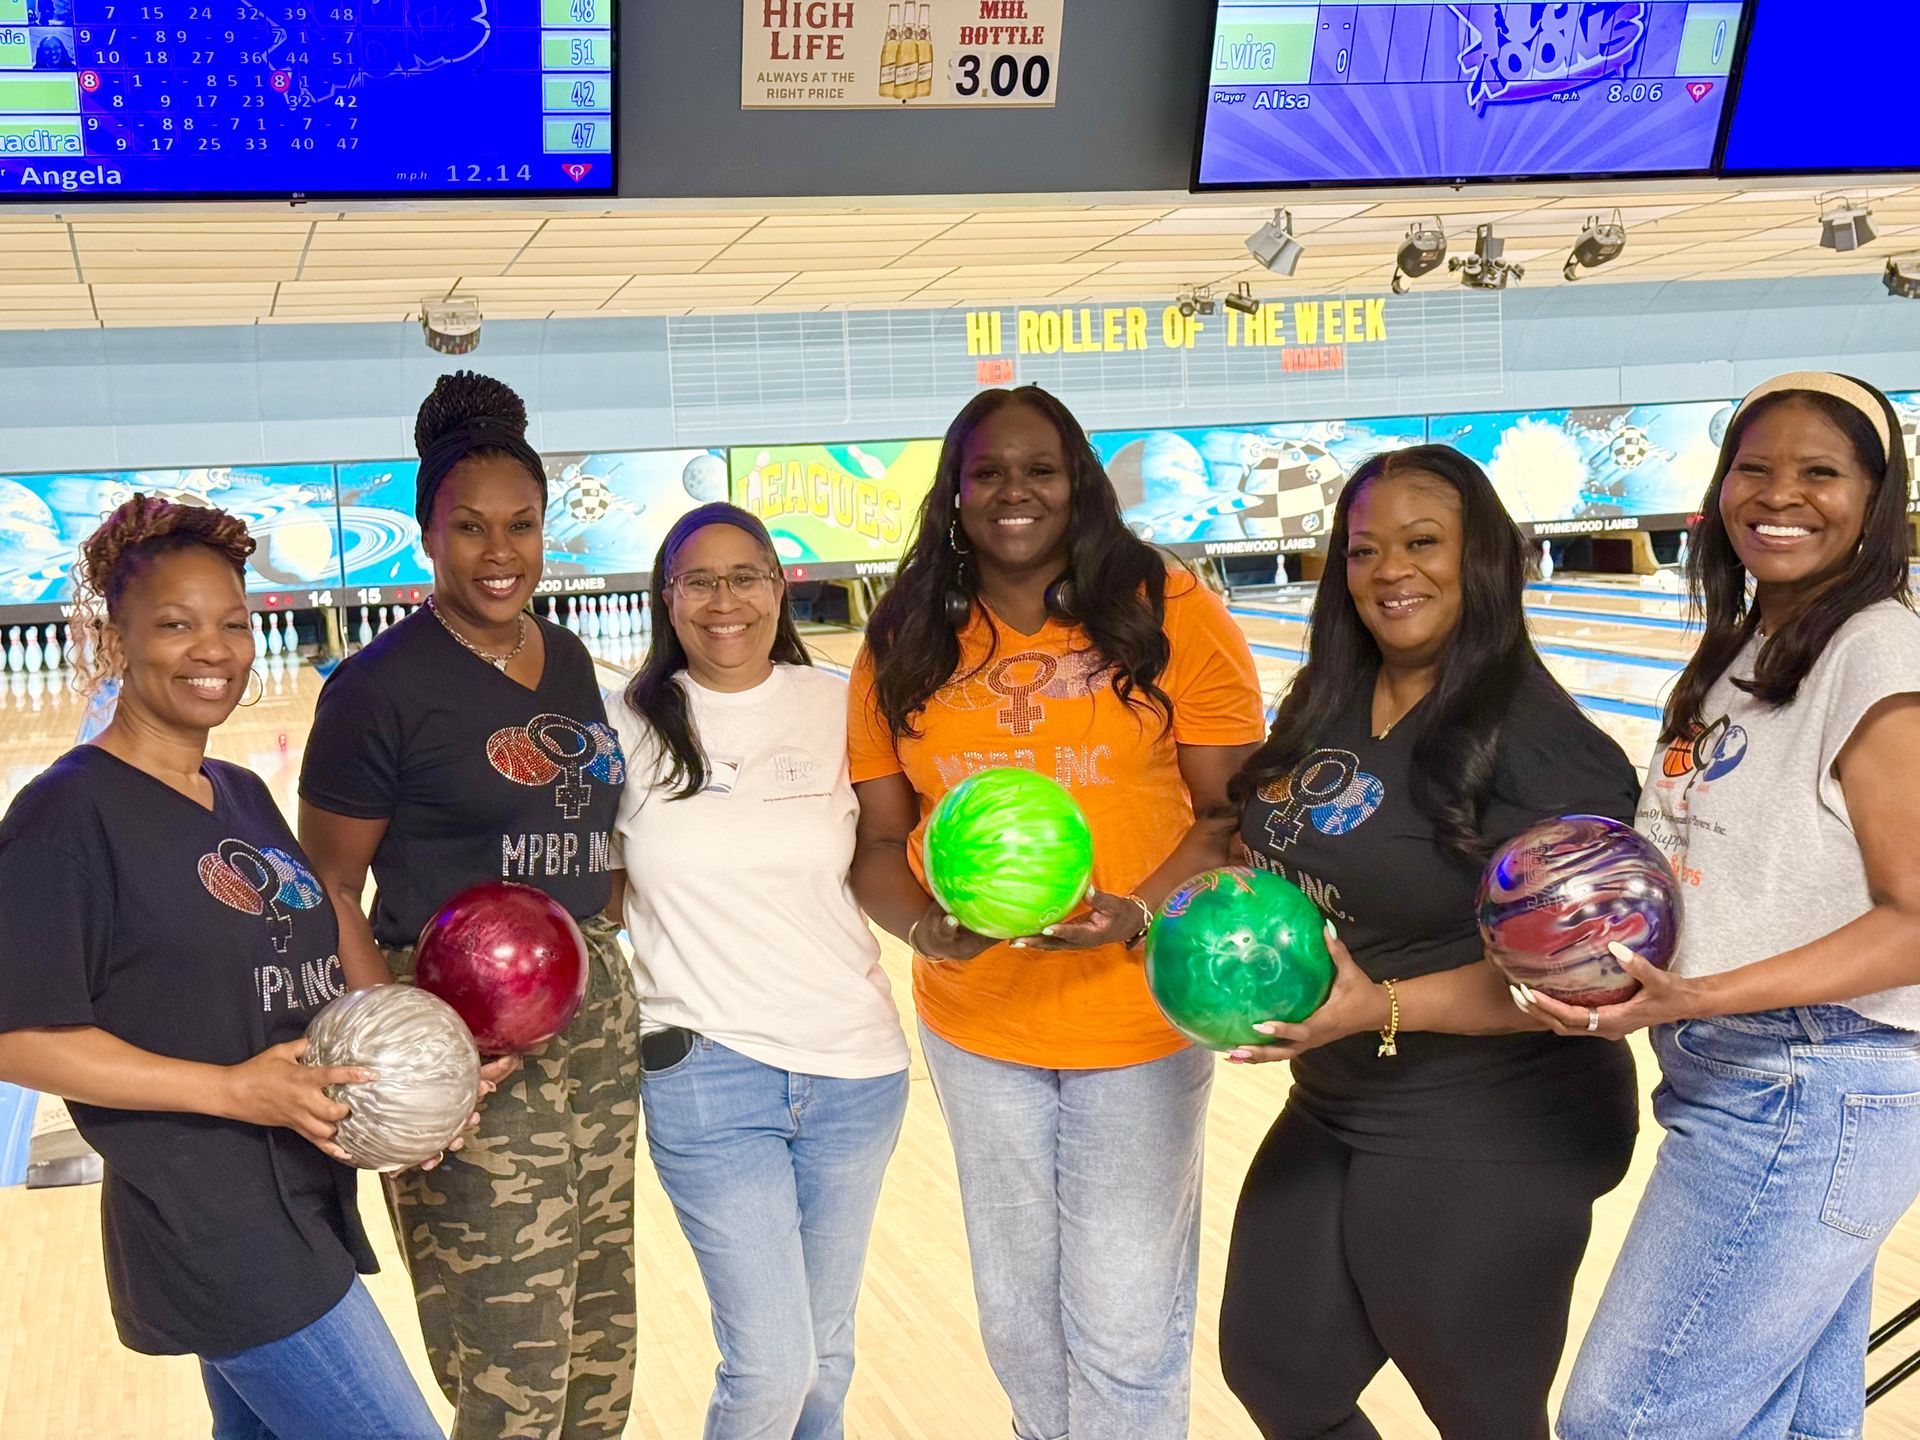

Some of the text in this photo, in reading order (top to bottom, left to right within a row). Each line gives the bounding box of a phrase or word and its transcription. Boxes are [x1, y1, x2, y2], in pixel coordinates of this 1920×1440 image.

[105, 7, 354, 21] 7 15 24 32 39 48
[570, 0, 595, 22] 48
[763, 0, 854, 28] HIGH
[80, 30, 91, 43] 9
[156, 30, 166, 43] 8
[177, 30, 187, 43] 9
[225, 30, 235, 43] 9
[344, 32, 353, 44] 7
[959, 25, 1045, 45] BOTTLE
[571, 39, 594, 65] 51
[770, 31, 845, 60] LIFE
[98, 51, 354, 65] 10 18 27 36 44 51
[83, 74, 96, 88] 8
[207, 75, 217, 88] 8
[228, 75, 237, 88] 5
[274, 74, 285, 88] 8
[757, 72, 855, 83] ALWAYS AT THE
[956, 55, 1050, 97] 3.00
[113, 95, 358, 108] 8 9 17 23 32 42
[571, 81, 595, 107] 42
[767, 88, 844, 99] RIGHT PRICE
[1214, 91, 1310, 110] Player Alisa
[1552, 83, 1663, 102] m.p.h. 8.06
[88, 118, 98, 131] 9
[163, 118, 173, 131] 8
[184, 118, 194, 131] 8
[230, 118, 240, 131] 7
[302, 118, 312, 131] 7
[349, 118, 358, 130] 7
[116, 138, 359, 151] 9 17 25 33 40 47
[571, 123, 595, 149] 47
[21, 165, 122, 191] Angela
[446, 164, 532, 182] 12.14
[966, 298, 1387, 355] HI ROLLER OF THE WEEK
[738, 460, 902, 544] LEAGUES
[1534, 518, 1638, 534] WYNNEWOOD LANES
[1204, 538, 1316, 555] WYNNEWOOD LANES
[565, 577, 605, 591] LANES
[308, 590, 333, 608] 14
[357, 588, 382, 605] 15
[502, 832, 581, 877] MPBP,
